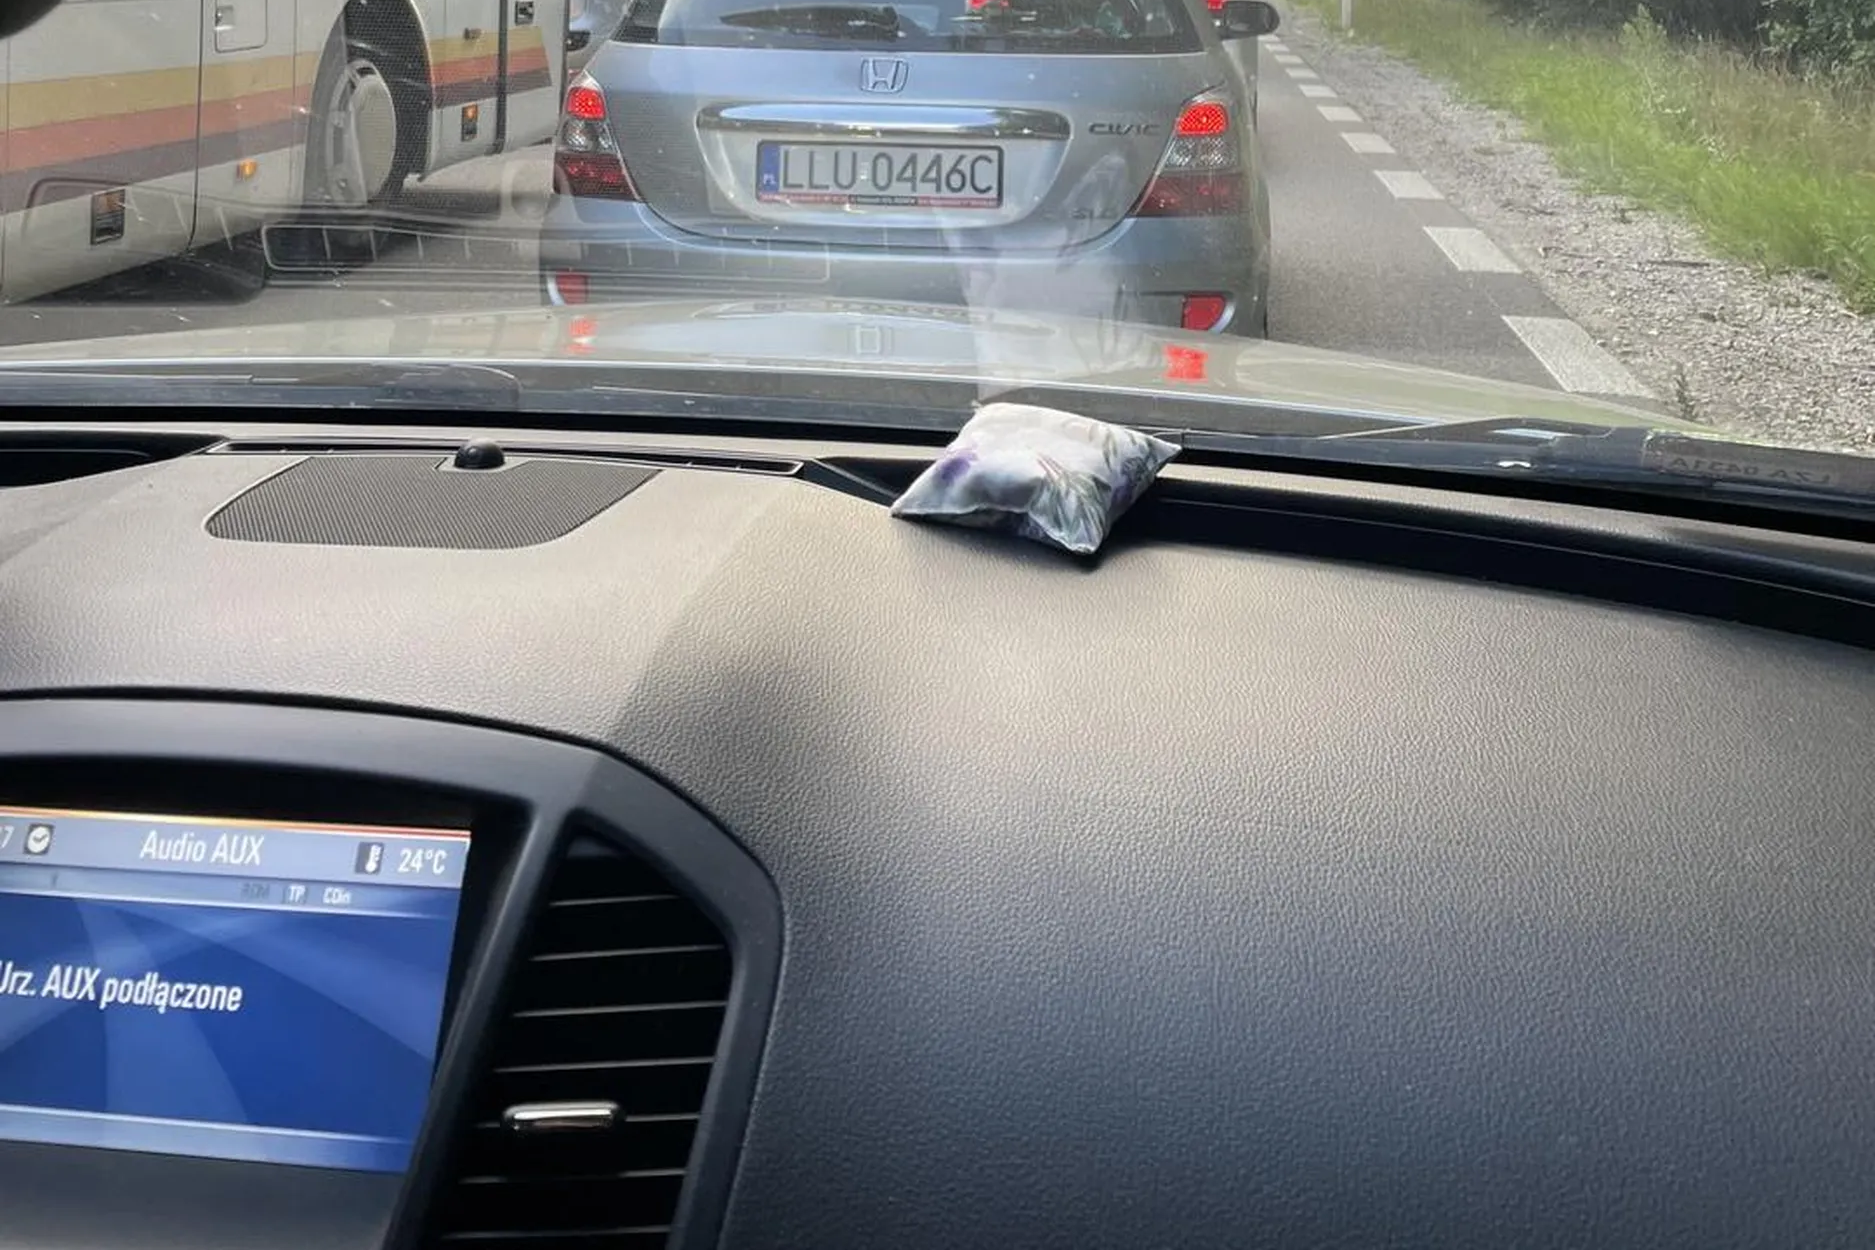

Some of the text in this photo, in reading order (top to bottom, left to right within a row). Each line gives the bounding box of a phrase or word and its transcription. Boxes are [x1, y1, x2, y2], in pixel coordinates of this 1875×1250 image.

[1088, 122, 1160, 135] CIVIC
[781, 150, 994, 194] LLU 0446C
[140, 829, 264, 866] Audio AUX
[397, 847, 448, 875] 24°C
[41, 963, 101, 1001] AUX
[99, 971, 243, 1014] podłączone
